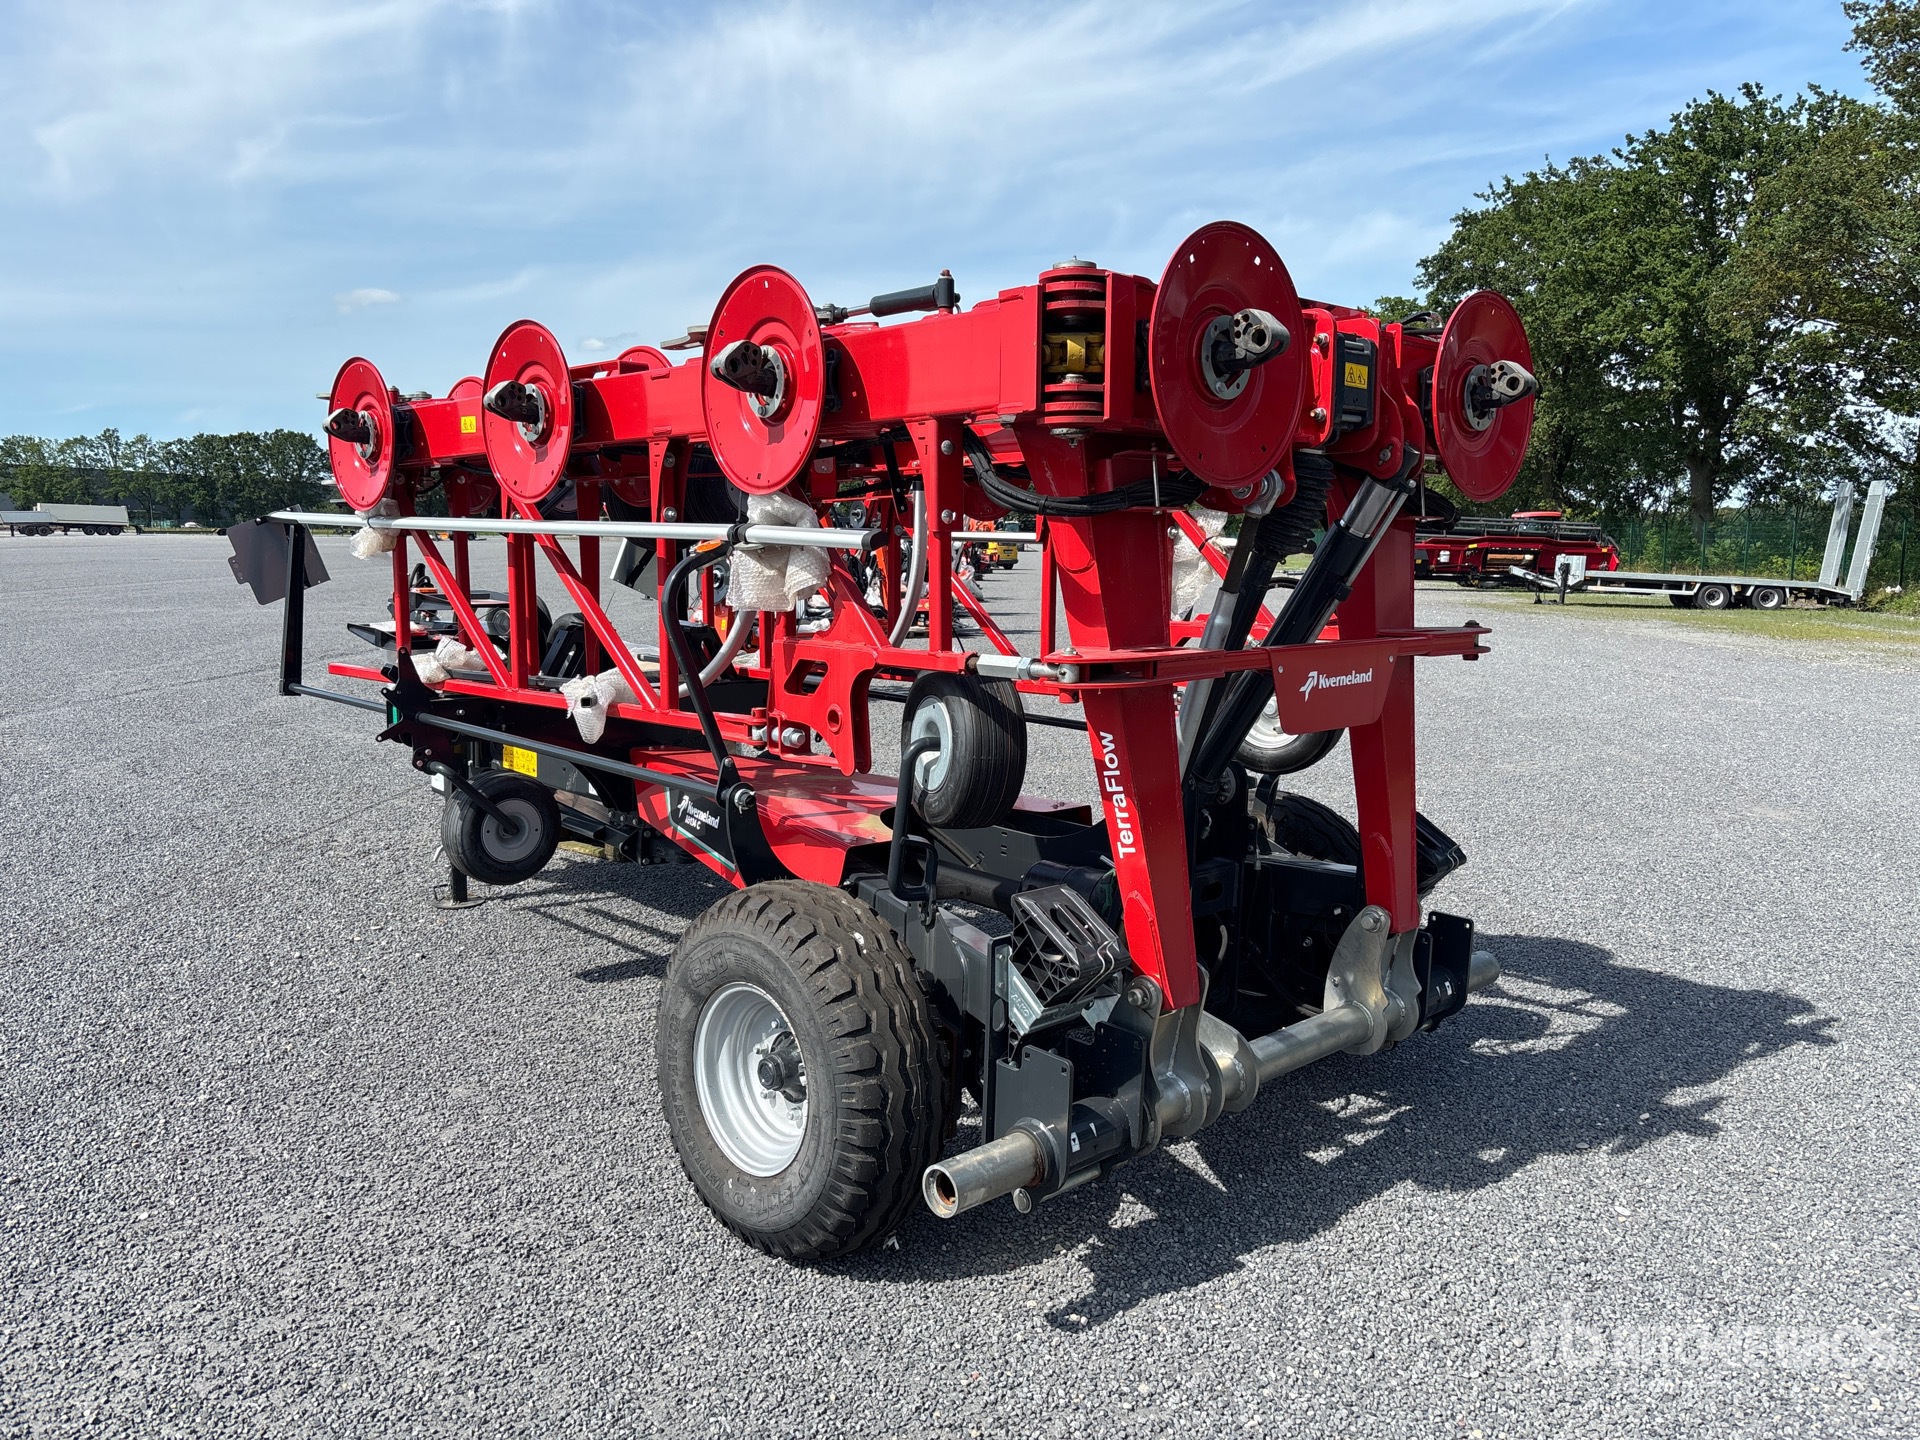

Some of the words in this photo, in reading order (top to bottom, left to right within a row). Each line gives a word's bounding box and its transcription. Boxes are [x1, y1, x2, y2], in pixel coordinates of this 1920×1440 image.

[1318, 667, 1372, 689] Kverneland
[1099, 731, 1136, 860] TerraFlow
[686, 800, 720, 829] Kverneland
